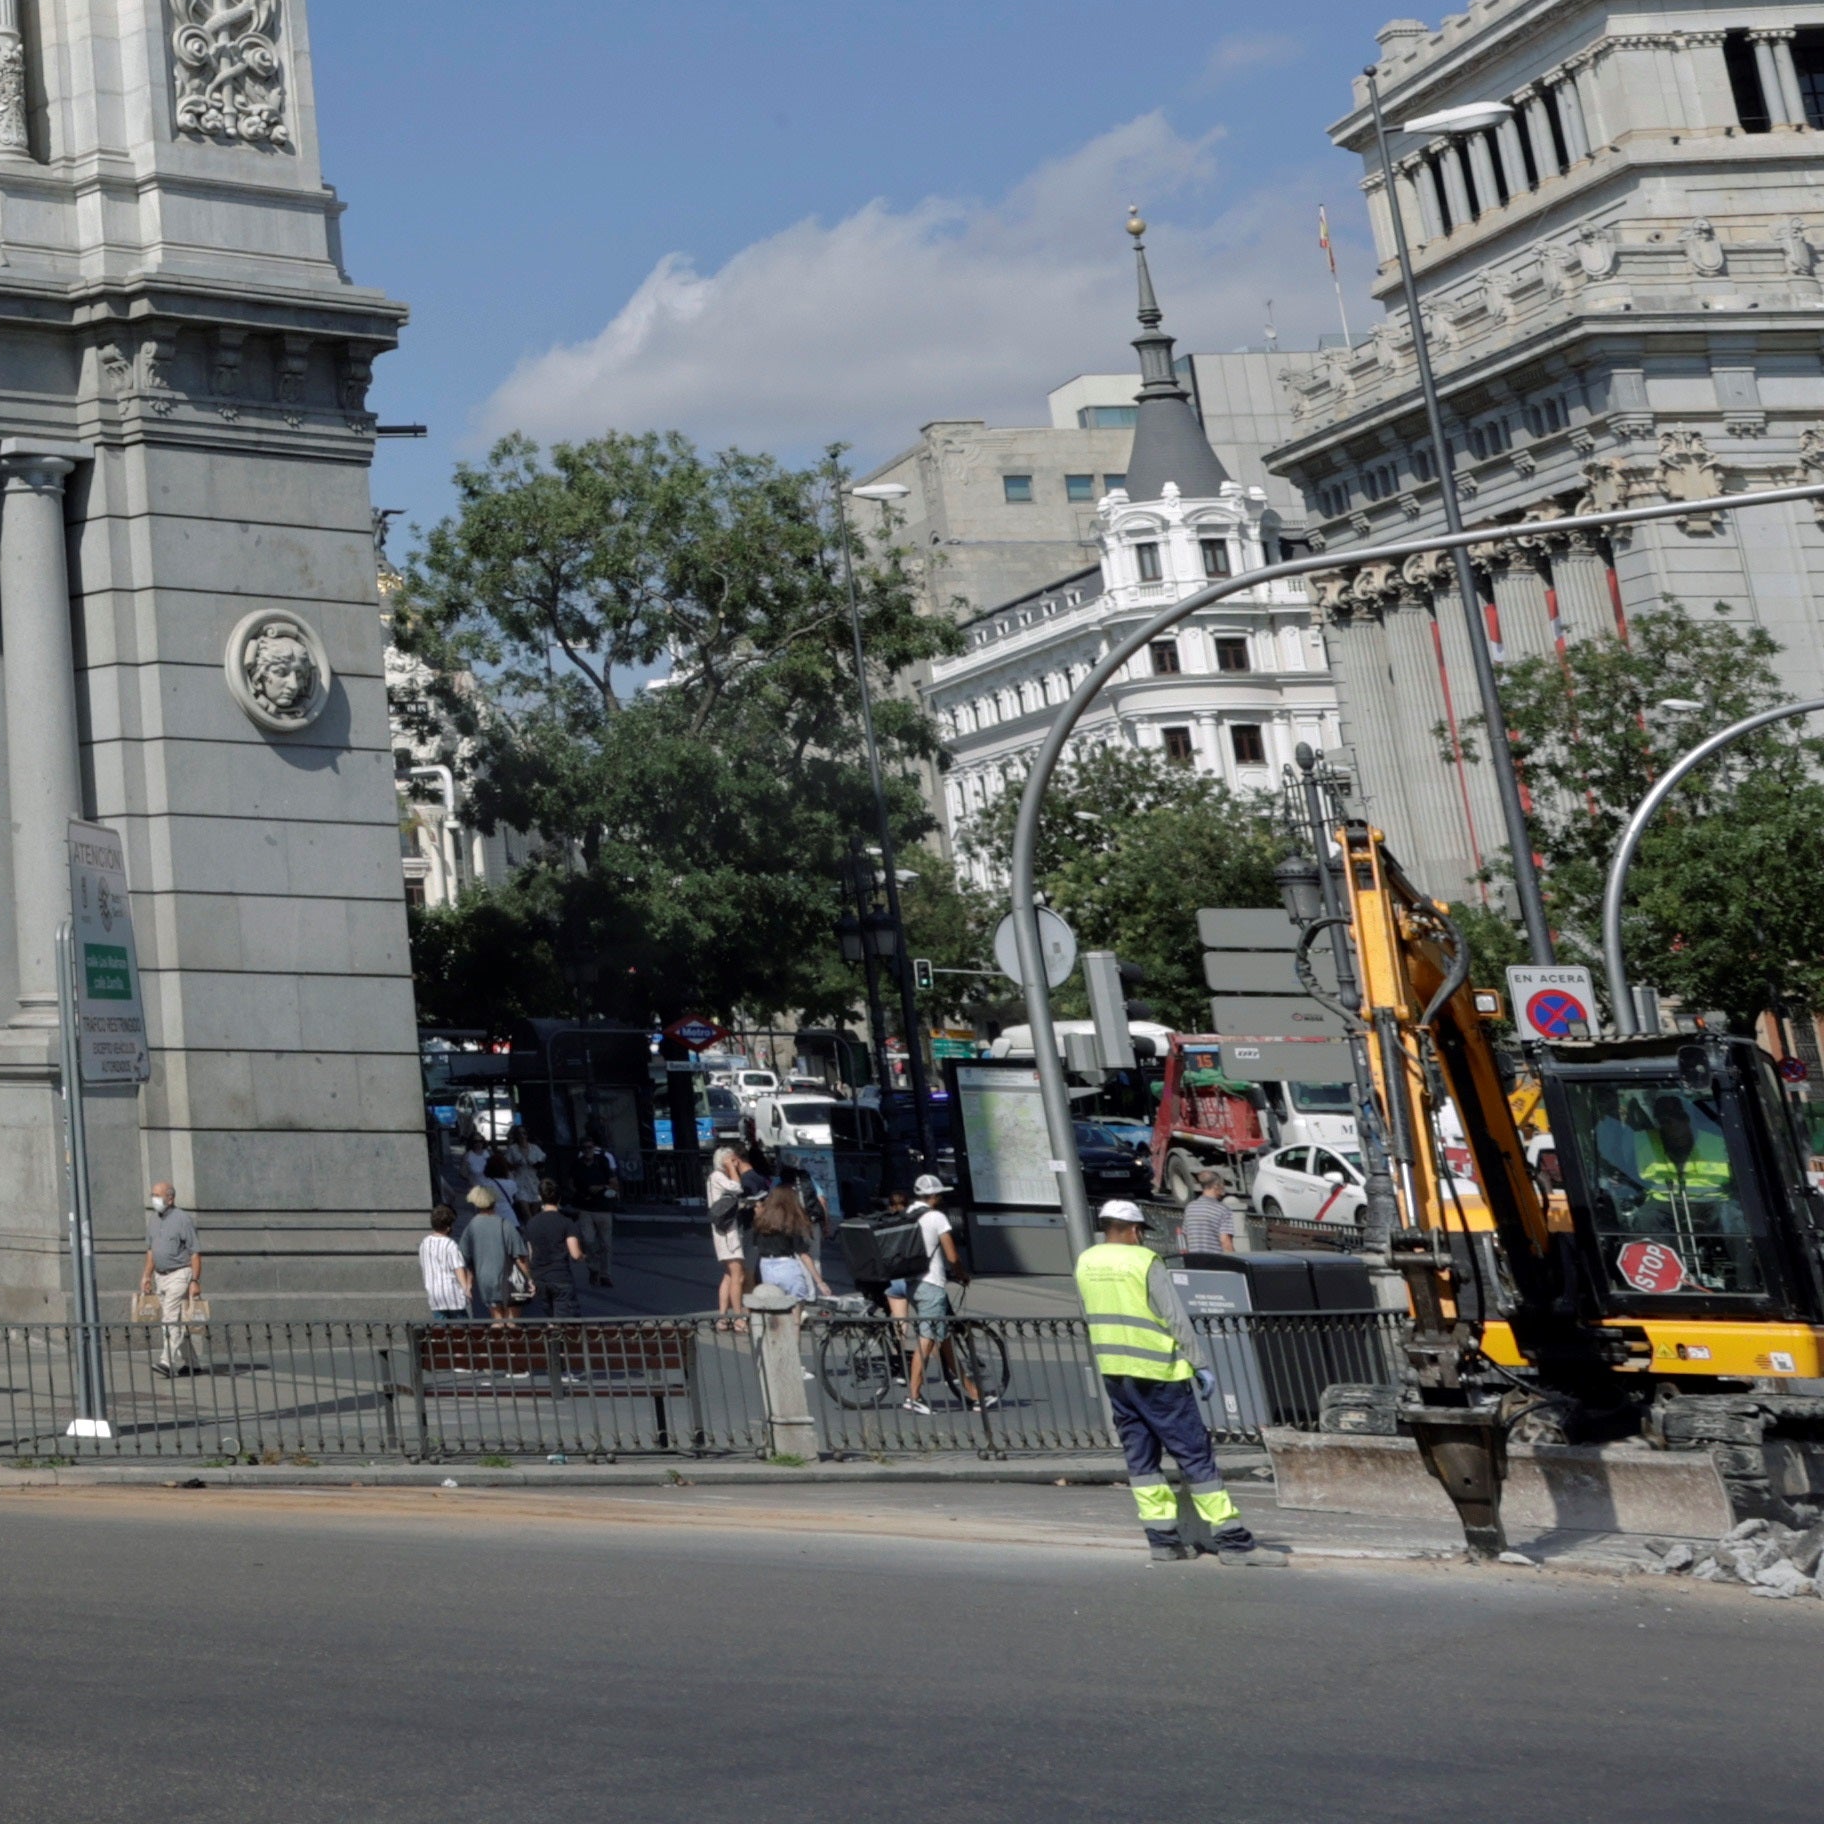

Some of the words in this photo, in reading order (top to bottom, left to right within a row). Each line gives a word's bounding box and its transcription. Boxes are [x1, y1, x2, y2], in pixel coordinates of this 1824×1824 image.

[73, 841, 123, 871] ATENCIÓN
[1514, 974, 1532, 983] EN
[1540, 974, 1585, 983] ACERA
[681, 1027, 711, 1038] Metro
[1195, 1054, 1214, 1069] 15
[1634, 1244, 1666, 1289] STOP
